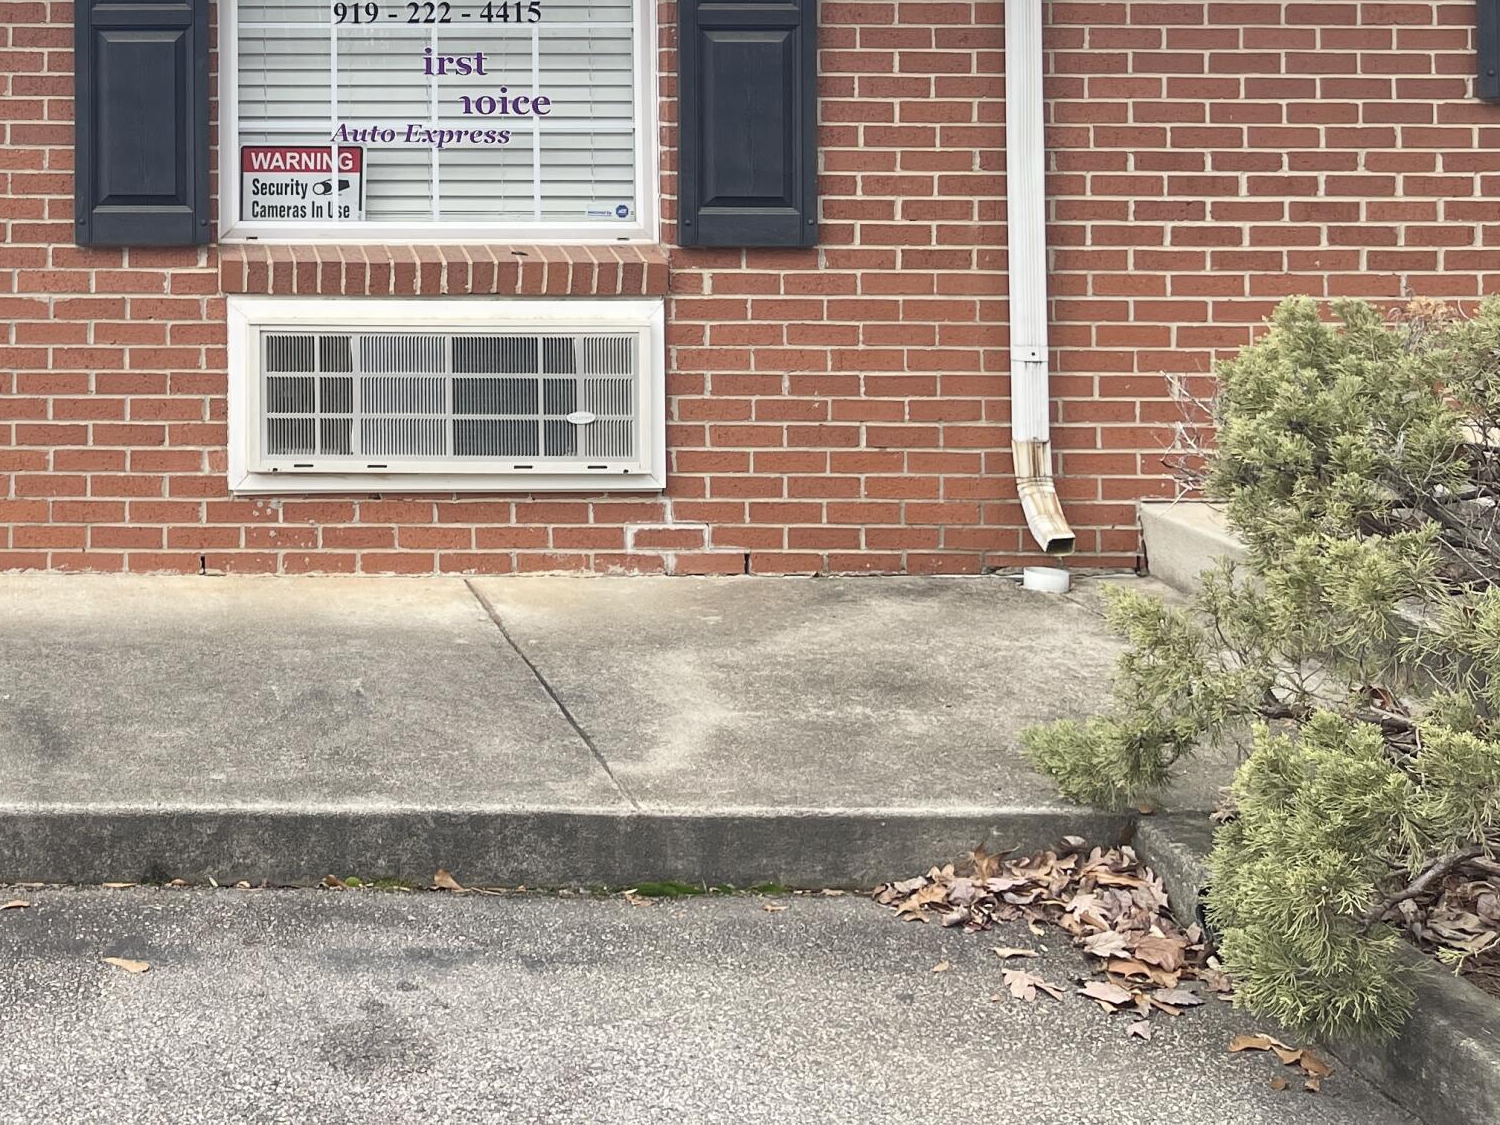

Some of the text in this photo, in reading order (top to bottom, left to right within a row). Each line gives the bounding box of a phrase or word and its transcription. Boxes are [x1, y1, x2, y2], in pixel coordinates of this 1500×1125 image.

[333, 1, 379, 24] 919
[406, 1, 452, 24] 222
[479, 0, 542, 24] 4415
[423, 47, 488, 76] irst
[330, 123, 511, 149] Auto Express
[250, 152, 354, 170] WARNING
[252, 178, 308, 200] Security
[251, 200, 307, 218] Cameras
[311, 200, 323, 218] In
